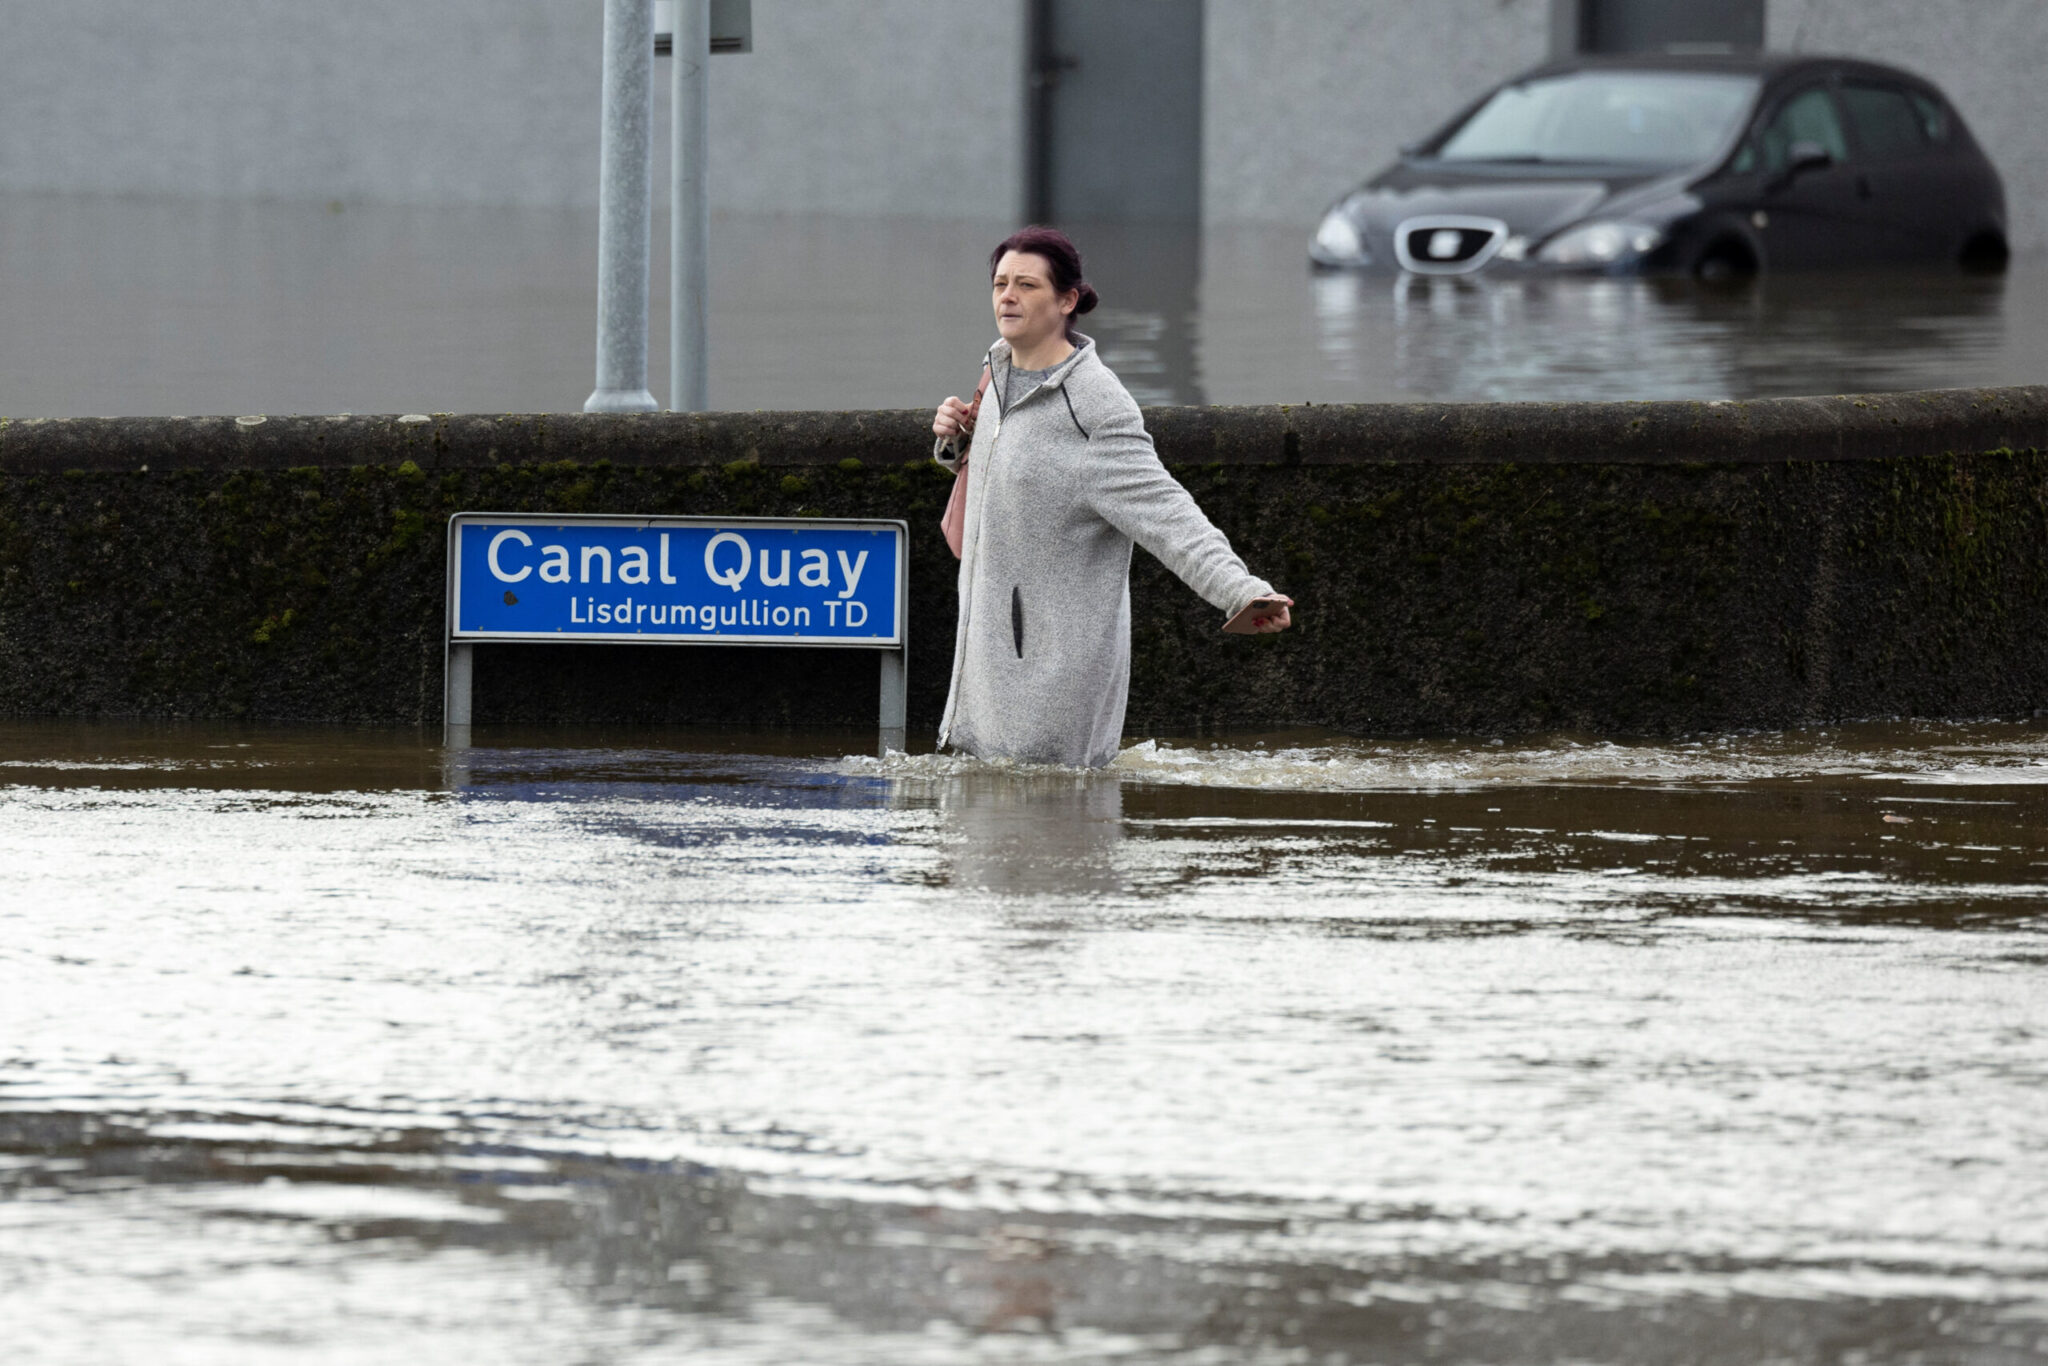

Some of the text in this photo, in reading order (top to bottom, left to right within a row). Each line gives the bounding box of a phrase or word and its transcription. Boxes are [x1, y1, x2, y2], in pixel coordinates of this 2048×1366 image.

[487, 529, 869, 599] Canal Quay
[570, 597, 868, 631] Lisdrumgullion TD
